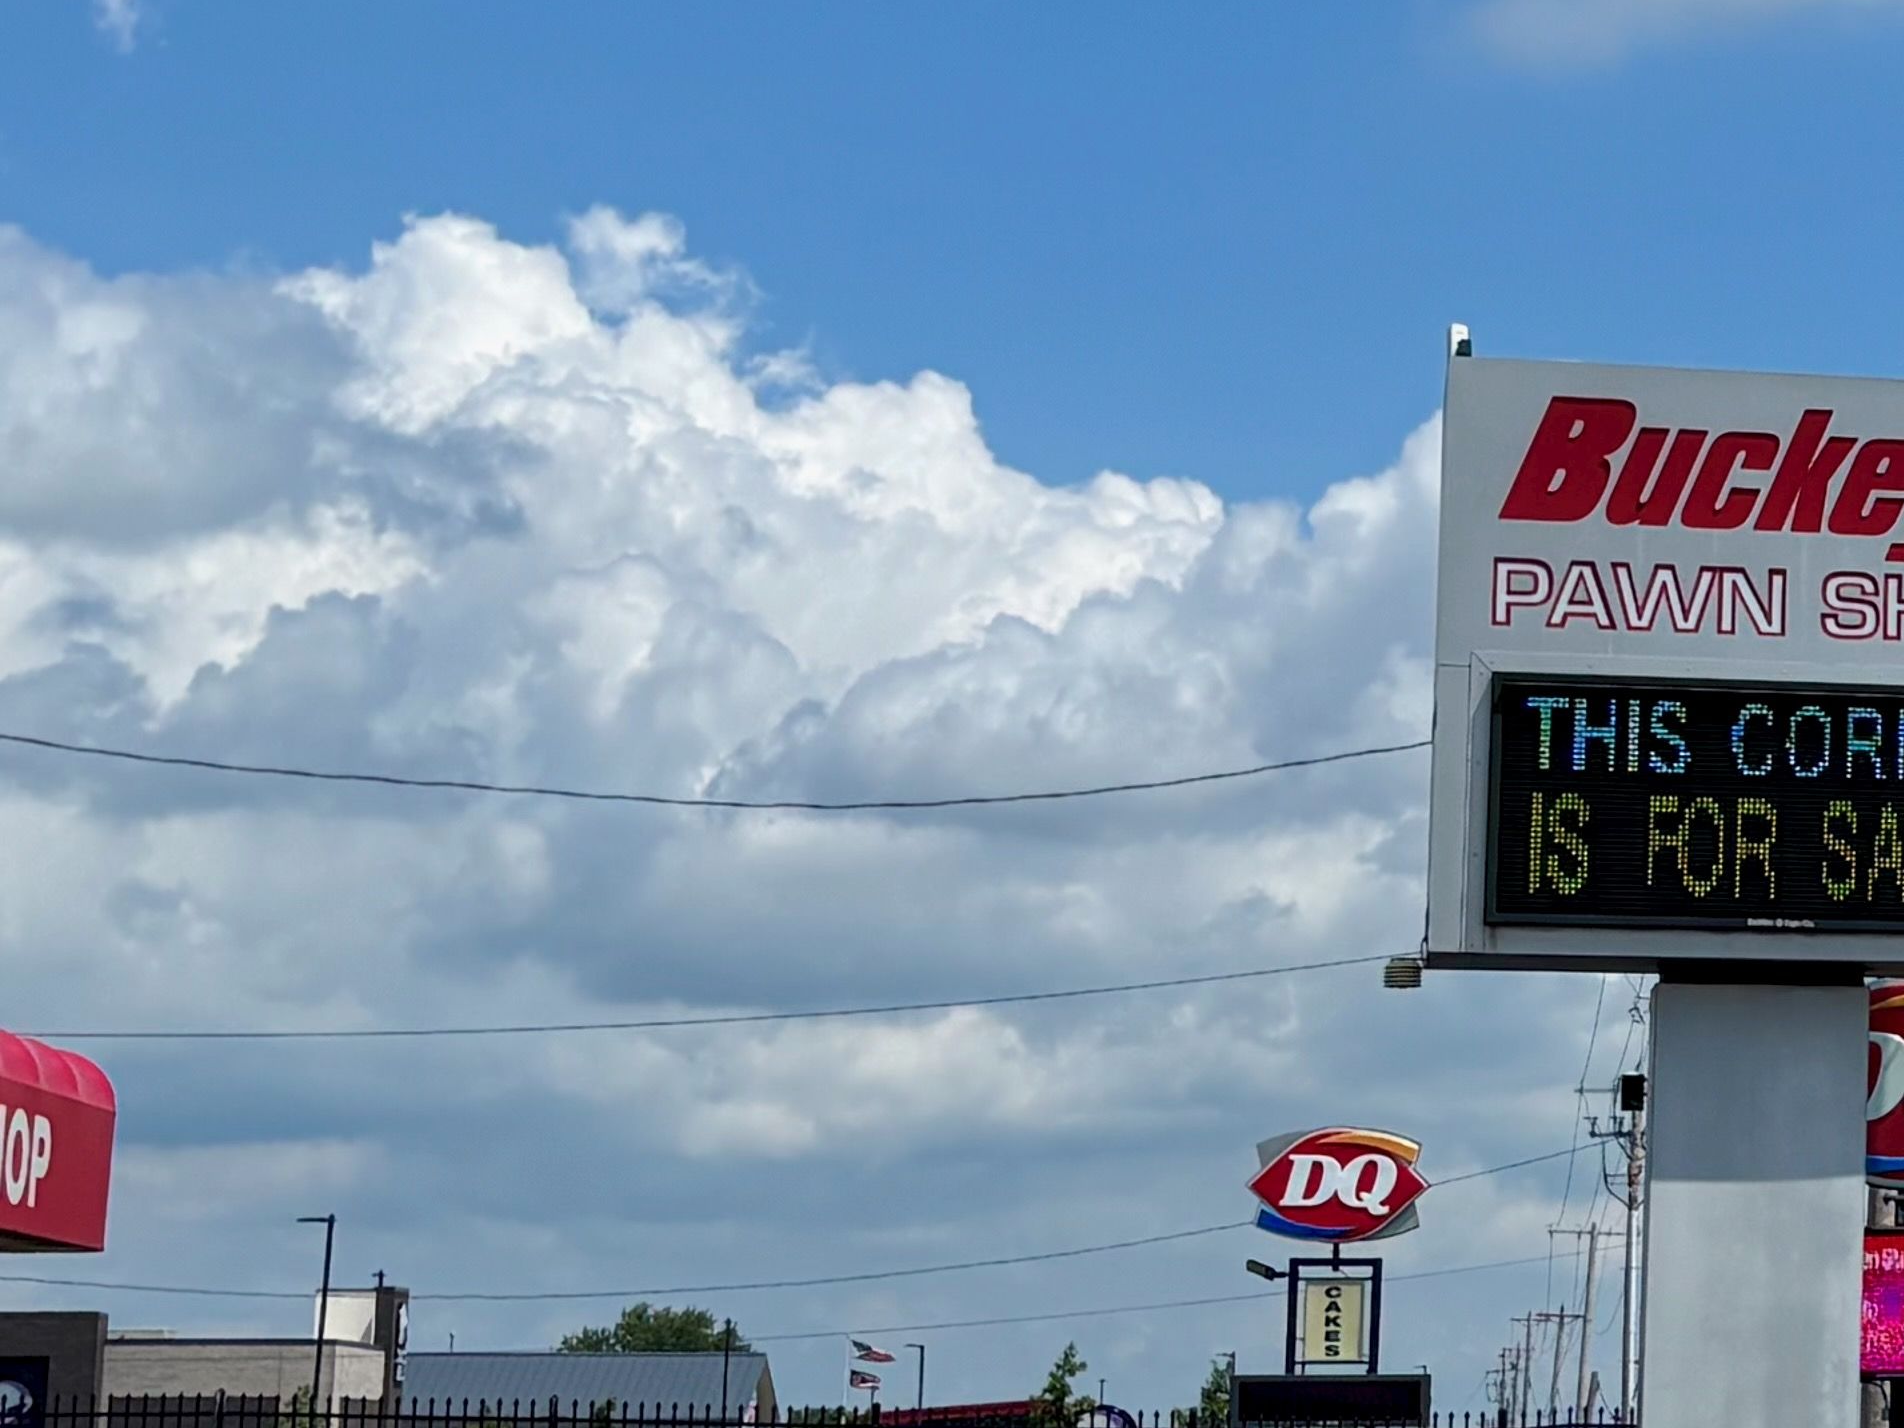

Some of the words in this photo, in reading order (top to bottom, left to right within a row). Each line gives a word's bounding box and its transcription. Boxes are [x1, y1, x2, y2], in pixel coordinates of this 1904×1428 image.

[1490, 556, 1788, 638] PAWN
[1526, 695, 1692, 774] THIS
[1528, 791, 1590, 896] IS
[1646, 794, 1777, 900] FOR
[1278, 1153, 1399, 1216] DQ
[1324, 1286, 1342, 1357] CAKES
